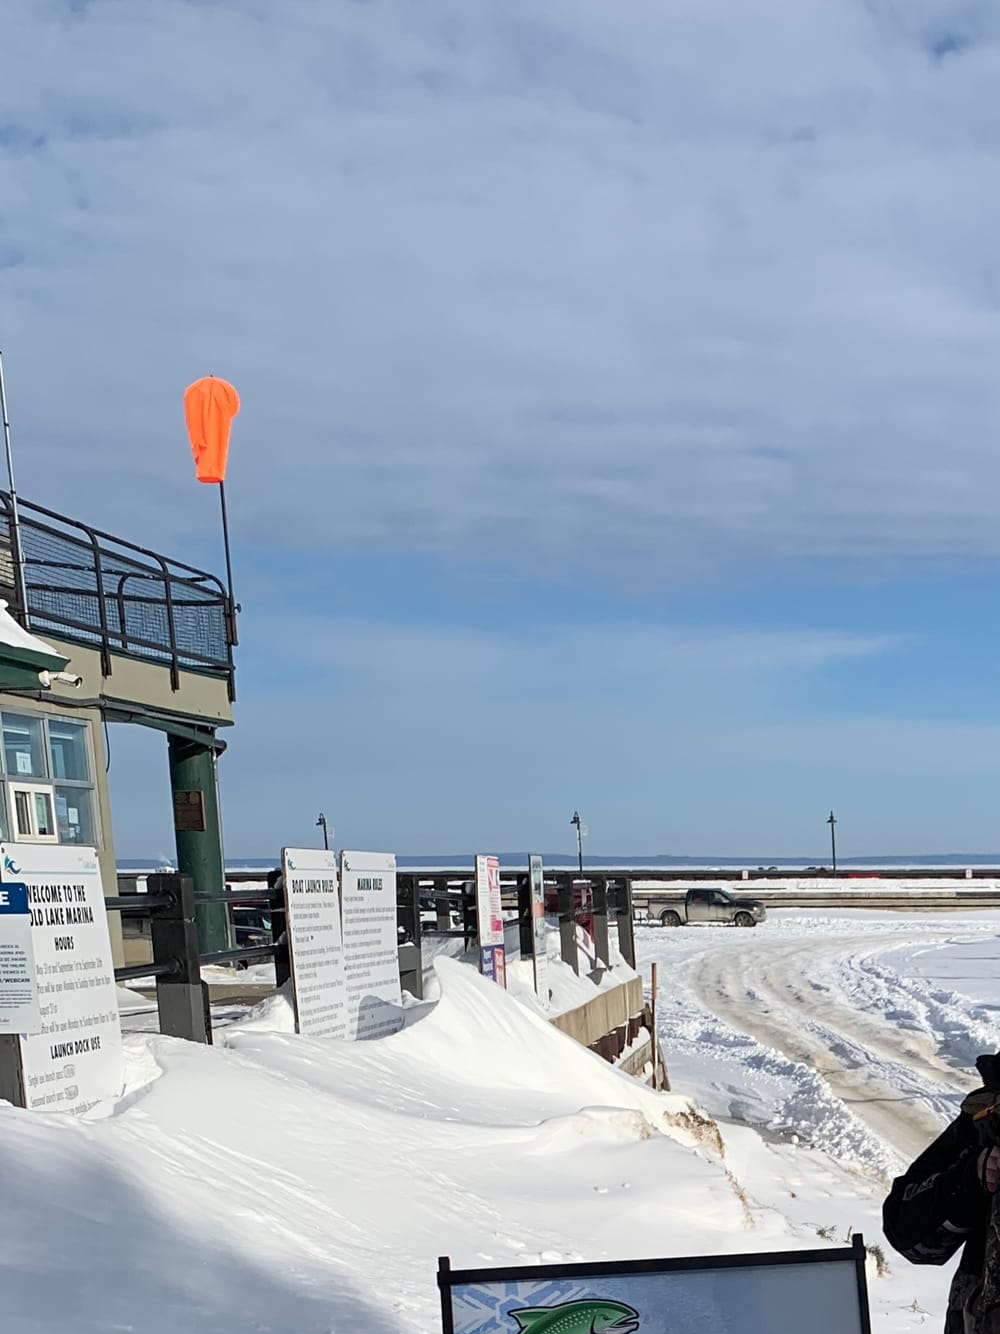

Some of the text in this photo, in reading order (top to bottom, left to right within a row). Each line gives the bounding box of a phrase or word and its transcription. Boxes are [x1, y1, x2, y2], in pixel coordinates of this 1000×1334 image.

[63, 885, 73, 903] TO
[73, 885, 86, 902] THE
[29, 906, 94, 927] OLD LAKE MARINA
[54, 936, 74, 951] HOURS
[50, 1036, 101, 1060] LAUNCH DOCK USE
